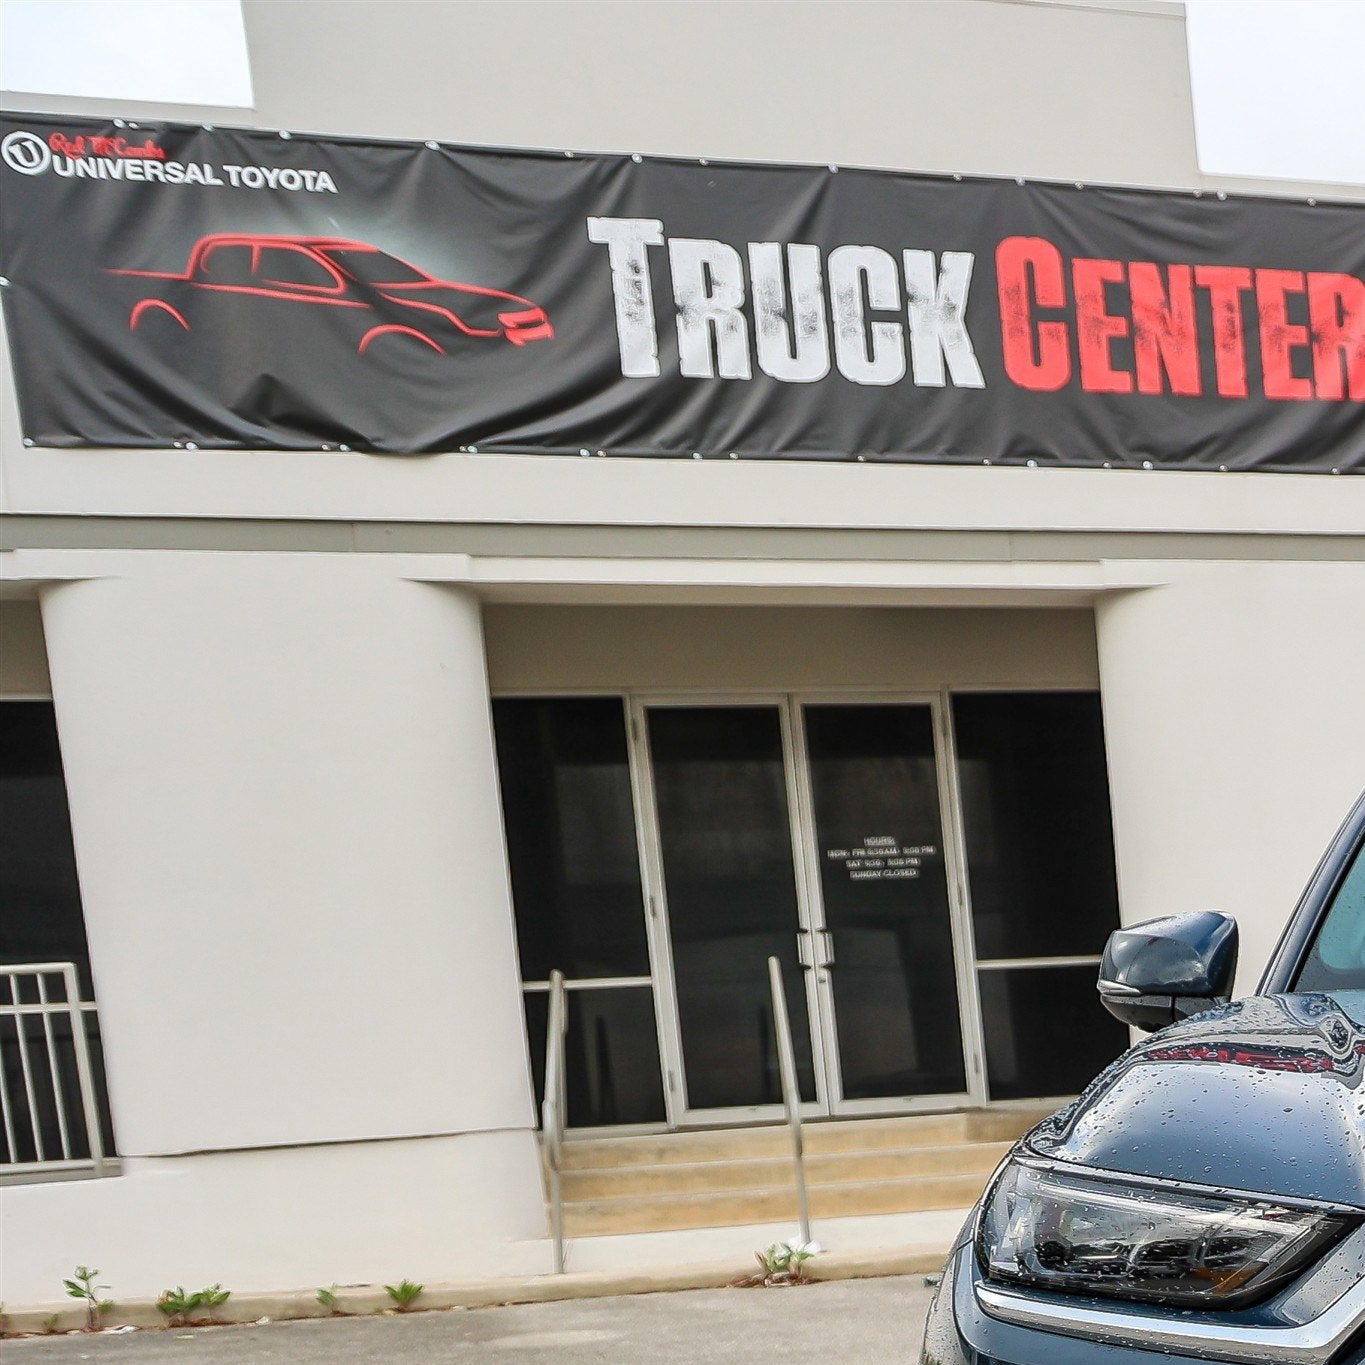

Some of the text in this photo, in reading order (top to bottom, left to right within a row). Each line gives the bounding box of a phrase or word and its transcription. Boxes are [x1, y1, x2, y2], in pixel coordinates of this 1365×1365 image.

[52, 154, 339, 194] UNIVERSAL TOYOTA
[587, 217, 986, 389] TRUCK
